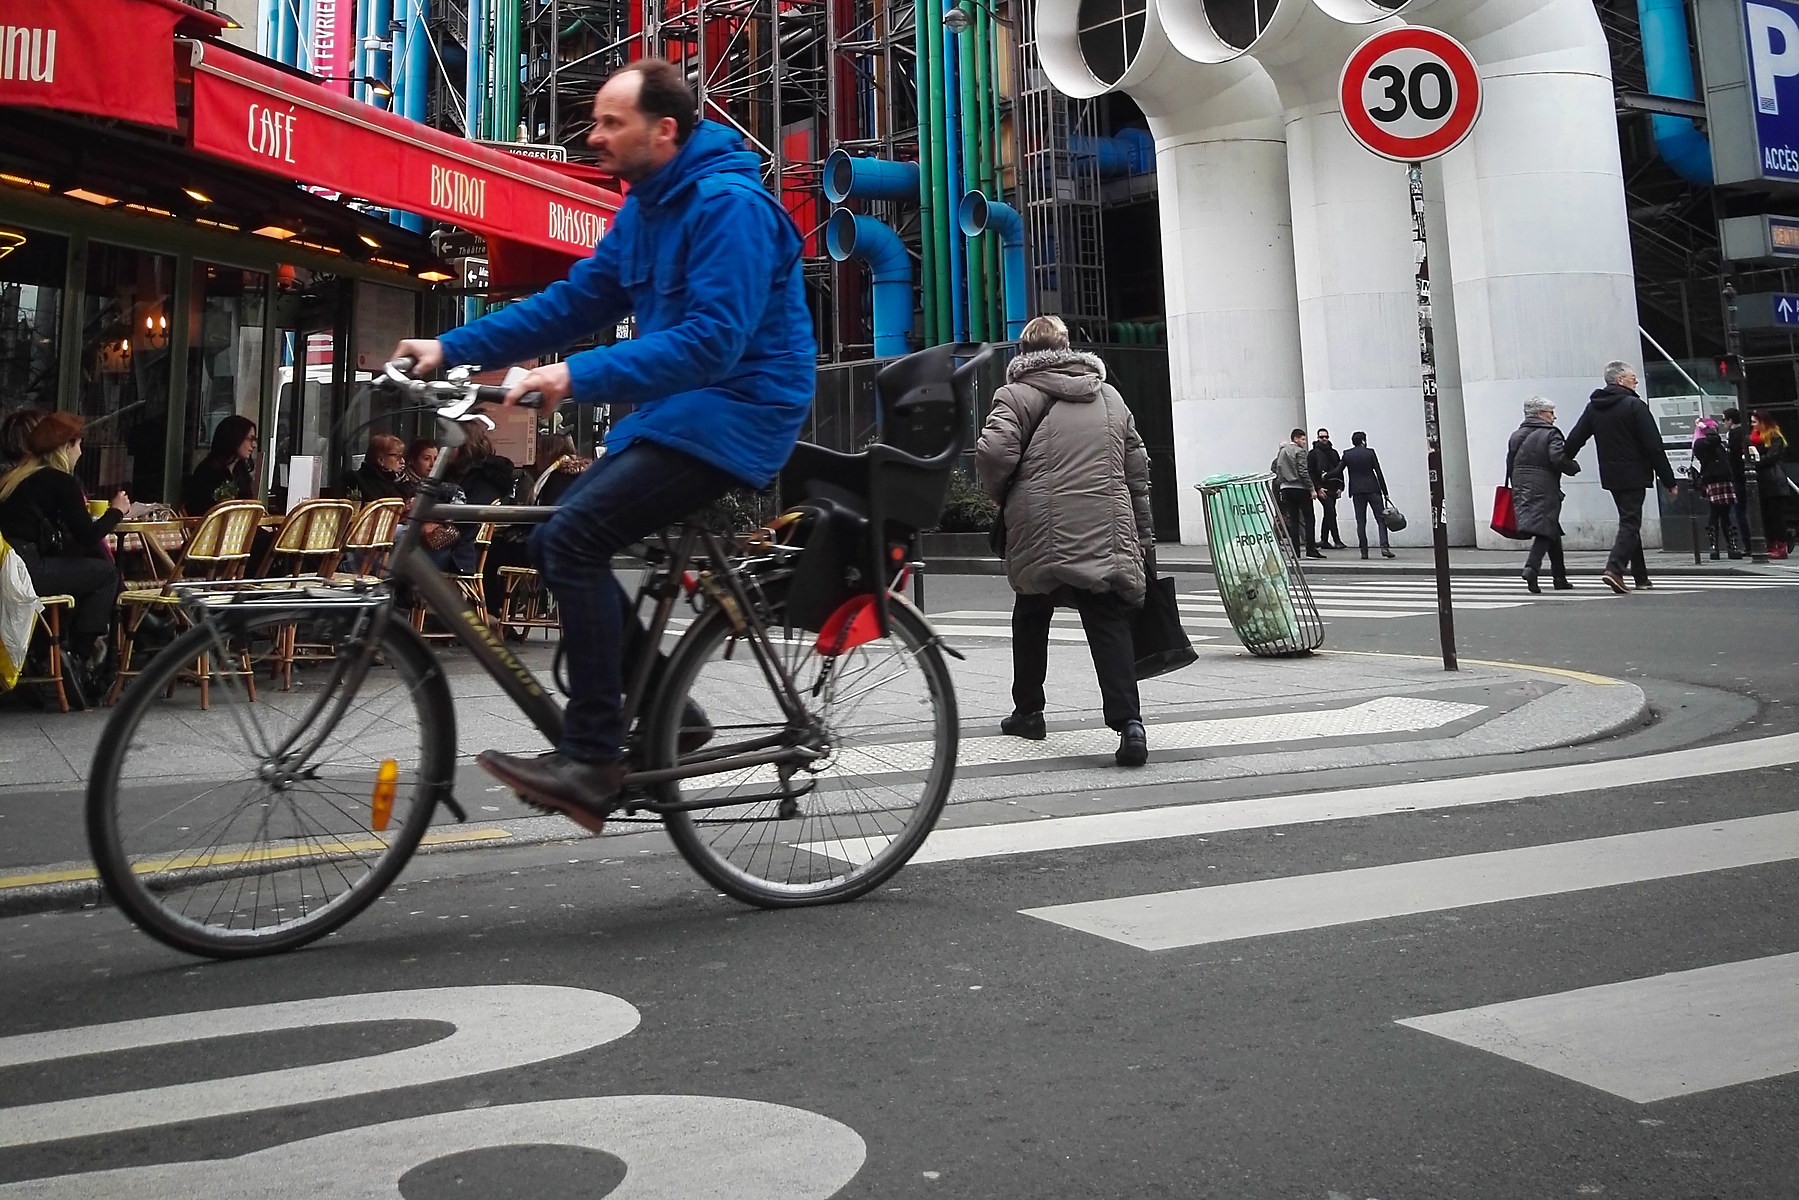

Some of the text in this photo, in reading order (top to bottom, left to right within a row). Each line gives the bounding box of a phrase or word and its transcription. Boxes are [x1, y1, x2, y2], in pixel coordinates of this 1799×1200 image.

[1746, 2, 1799, 115] P
[1368, 62, 1453, 123] 30
[247, 104, 297, 163] CAFÉ
[1764, 145, 1799, 173] ACCÈS
[430, 164, 486, 219] BISTROT
[548, 201, 608, 249] BRASSERIE
